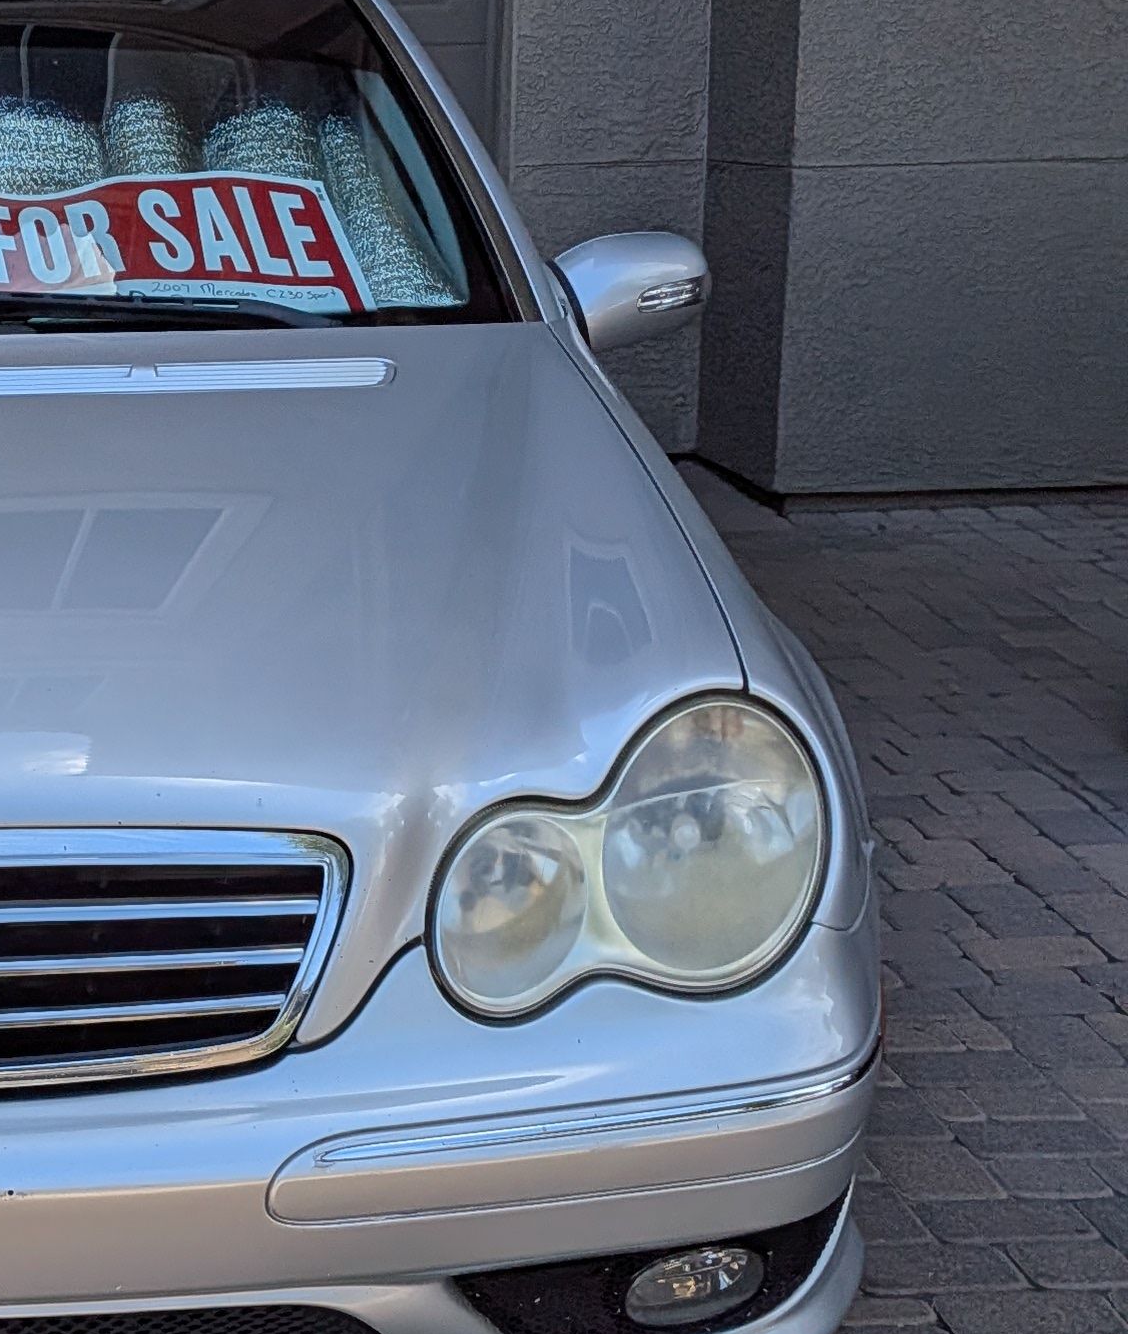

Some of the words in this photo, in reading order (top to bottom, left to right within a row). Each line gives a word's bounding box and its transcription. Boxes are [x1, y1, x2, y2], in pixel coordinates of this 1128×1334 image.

[137, 185, 335, 278] SALE
[151, 281, 190, 294] 2007
[266, 288, 304, 299] C230
